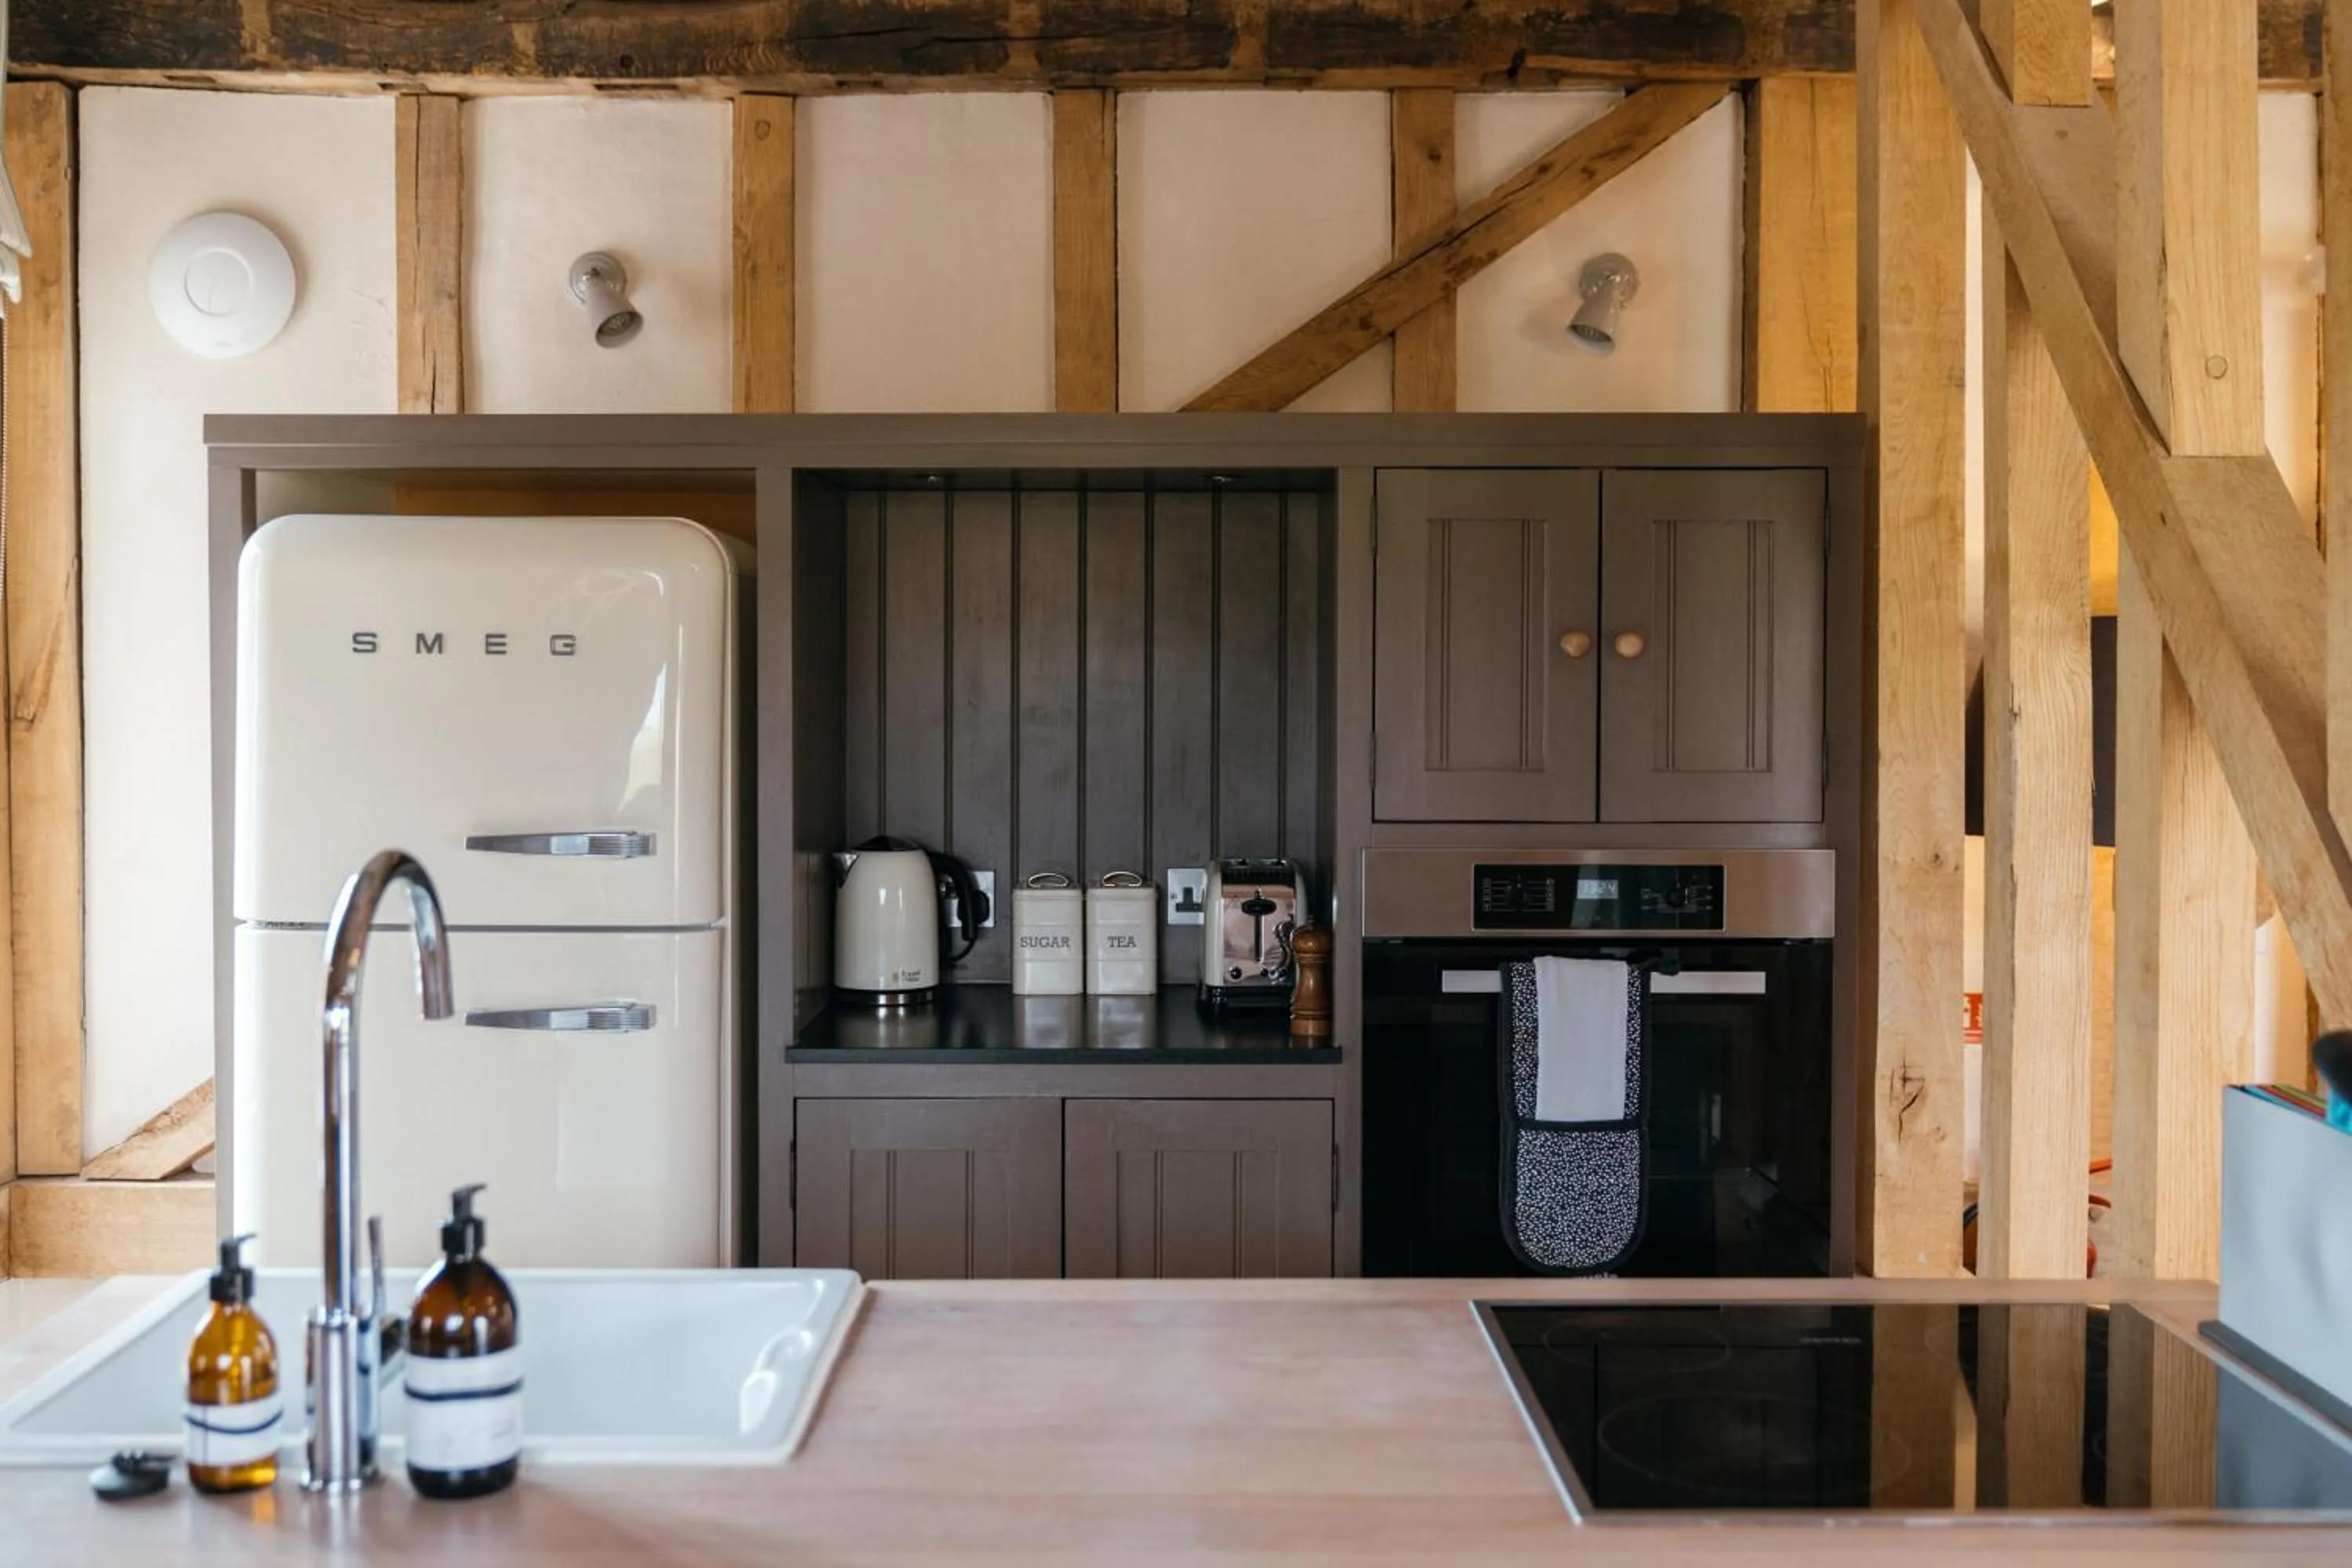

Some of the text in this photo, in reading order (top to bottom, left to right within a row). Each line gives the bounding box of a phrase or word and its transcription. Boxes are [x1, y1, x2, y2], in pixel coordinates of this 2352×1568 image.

[352, 632, 576, 655] SMEG
[1020, 936, 1070, 948] SUGAR
[1107, 936, 1136, 948] TEA
